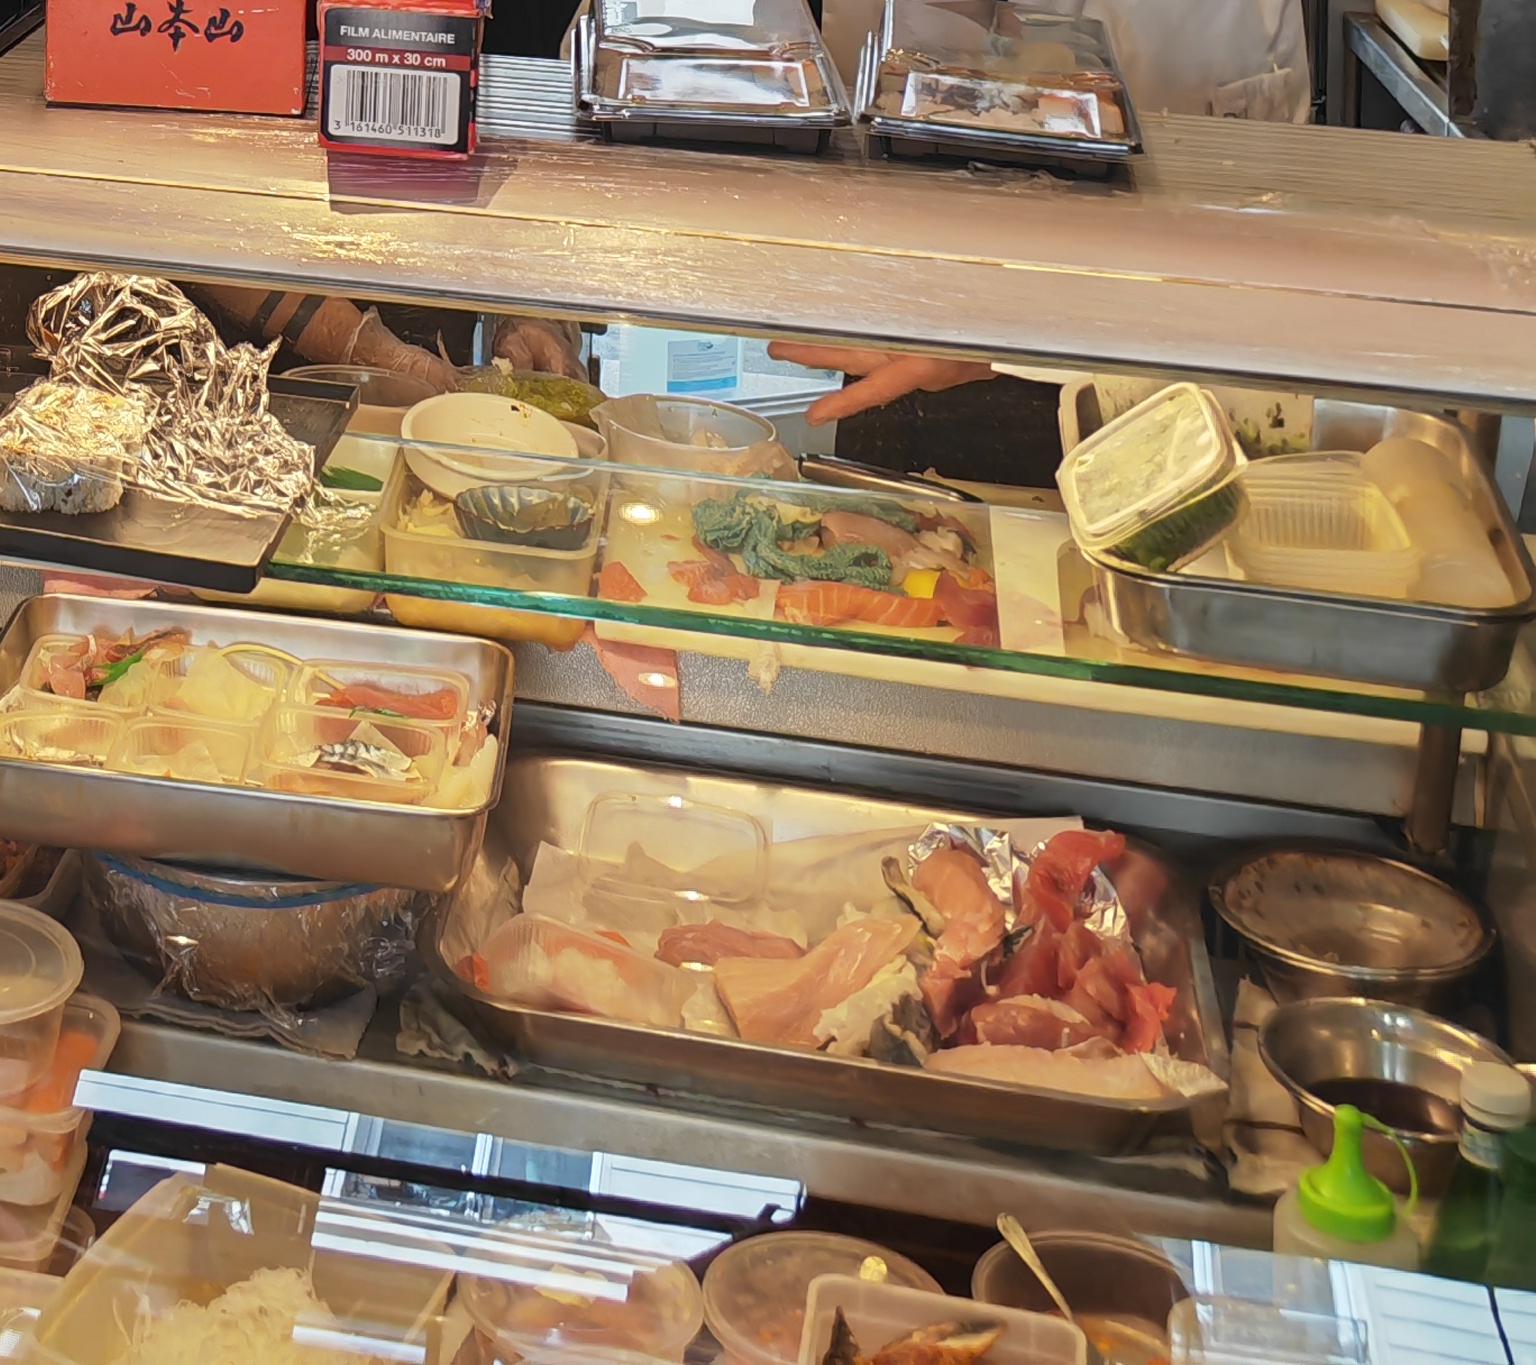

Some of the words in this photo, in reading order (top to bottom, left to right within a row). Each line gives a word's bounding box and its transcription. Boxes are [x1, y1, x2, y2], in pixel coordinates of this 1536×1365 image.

[340, 24, 368, 40] FILM
[369, 26, 456, 46] ALIMENTAIRE
[346, 48, 372, 64] 300
[375, 52, 389, 64] m
[392, 53, 401, 65] x
[404, 50, 423, 66] 30
[425, 55, 447, 68] cm
